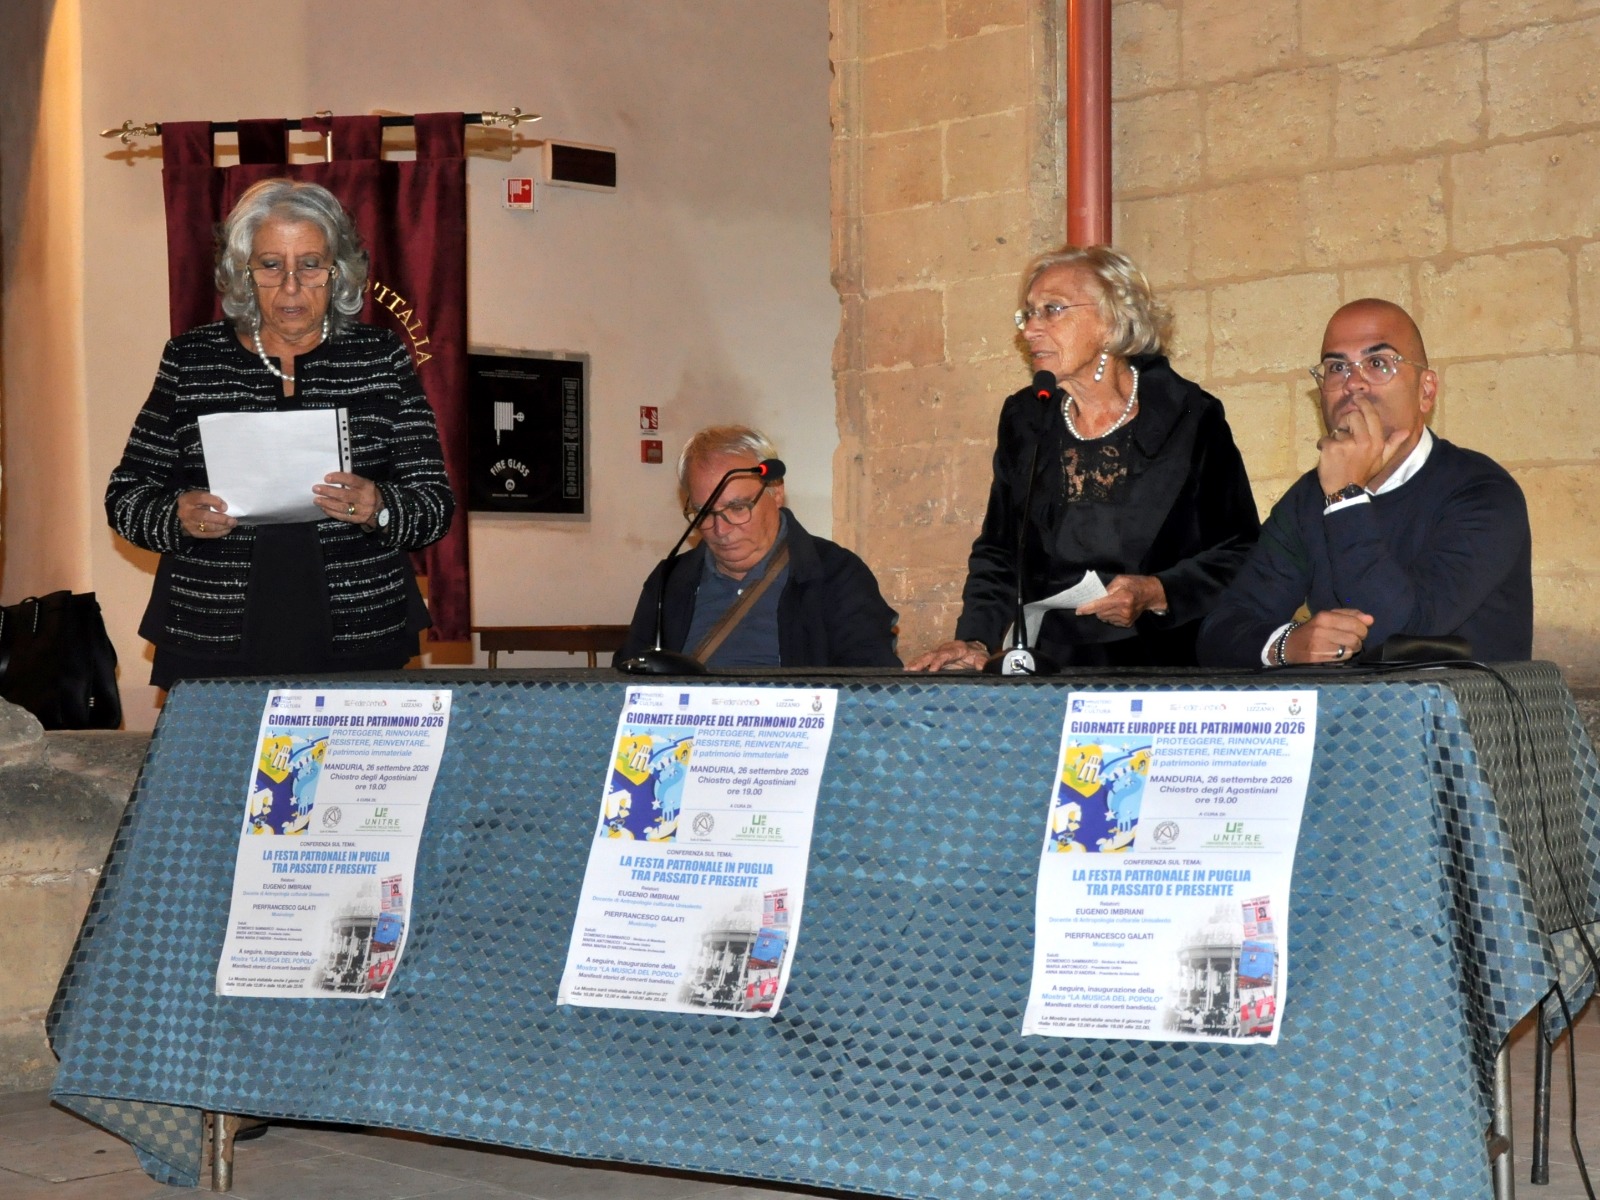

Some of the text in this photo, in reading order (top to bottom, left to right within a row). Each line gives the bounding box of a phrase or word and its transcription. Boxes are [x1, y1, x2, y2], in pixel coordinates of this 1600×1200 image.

[490, 459, 530, 477] FIRE GLASS
[268, 714, 444, 727] GIORNATE EUROPEE DEL PATRIMONIO 2026
[626, 712, 824, 728] GIORNATE EUROPEE DEL PATRIMONIO 2026
[1071, 721, 1305, 734] GIORNATE EUROPEE DEL PATRIMONIO 2026
[332, 730, 383, 738] PROTEGGERE,
[698, 729, 809, 740] PROTEGGERE, RINNOVARE,
[695, 739, 742, 748] RESISTERE,
[1156, 738, 1288, 746] PROTEGGERE, RINNOVARE,
[699, 750, 740, 759] patrimonio
[1154, 748, 1210, 757] RESISTERE,
[324, 764, 364, 772] MANDURIA,
[1152, 759, 1158, 767] il
[1160, 760, 1209, 769] patrimonio
[690, 766, 736, 774] MANDURIA,
[749, 767, 788, 775] settembre
[698, 776, 796, 786] Chiostro degli Agostiniani
[1150, 776, 1204, 784] MANDURIA,
[1201, 786, 1224, 795] degli
[1226, 786, 1278, 795] Agostiniani
[742, 826, 781, 834] UNITRE
[262, 850, 390, 862] LA FESTA PATRONALE IN PUGLIA
[272, 863, 377, 874] TRA PASSATO E PRESENTE
[620, 856, 774, 874] LA FESTA PATRONALE IN PUGLIA
[631, 870, 758, 888] TRA PASSATO E PRESENTE
[1072, 870, 1251, 882] LA FESTA PATRONALE IN PUGLIA
[618, 890, 680, 900] EUGENIO IMBRIANI
[1086, 884, 1234, 896] TRA PASSATO E PRESENTE
[604, 910, 660, 920] PIERFRANCESCO
[618, 960, 660, 970] inaugurazione
